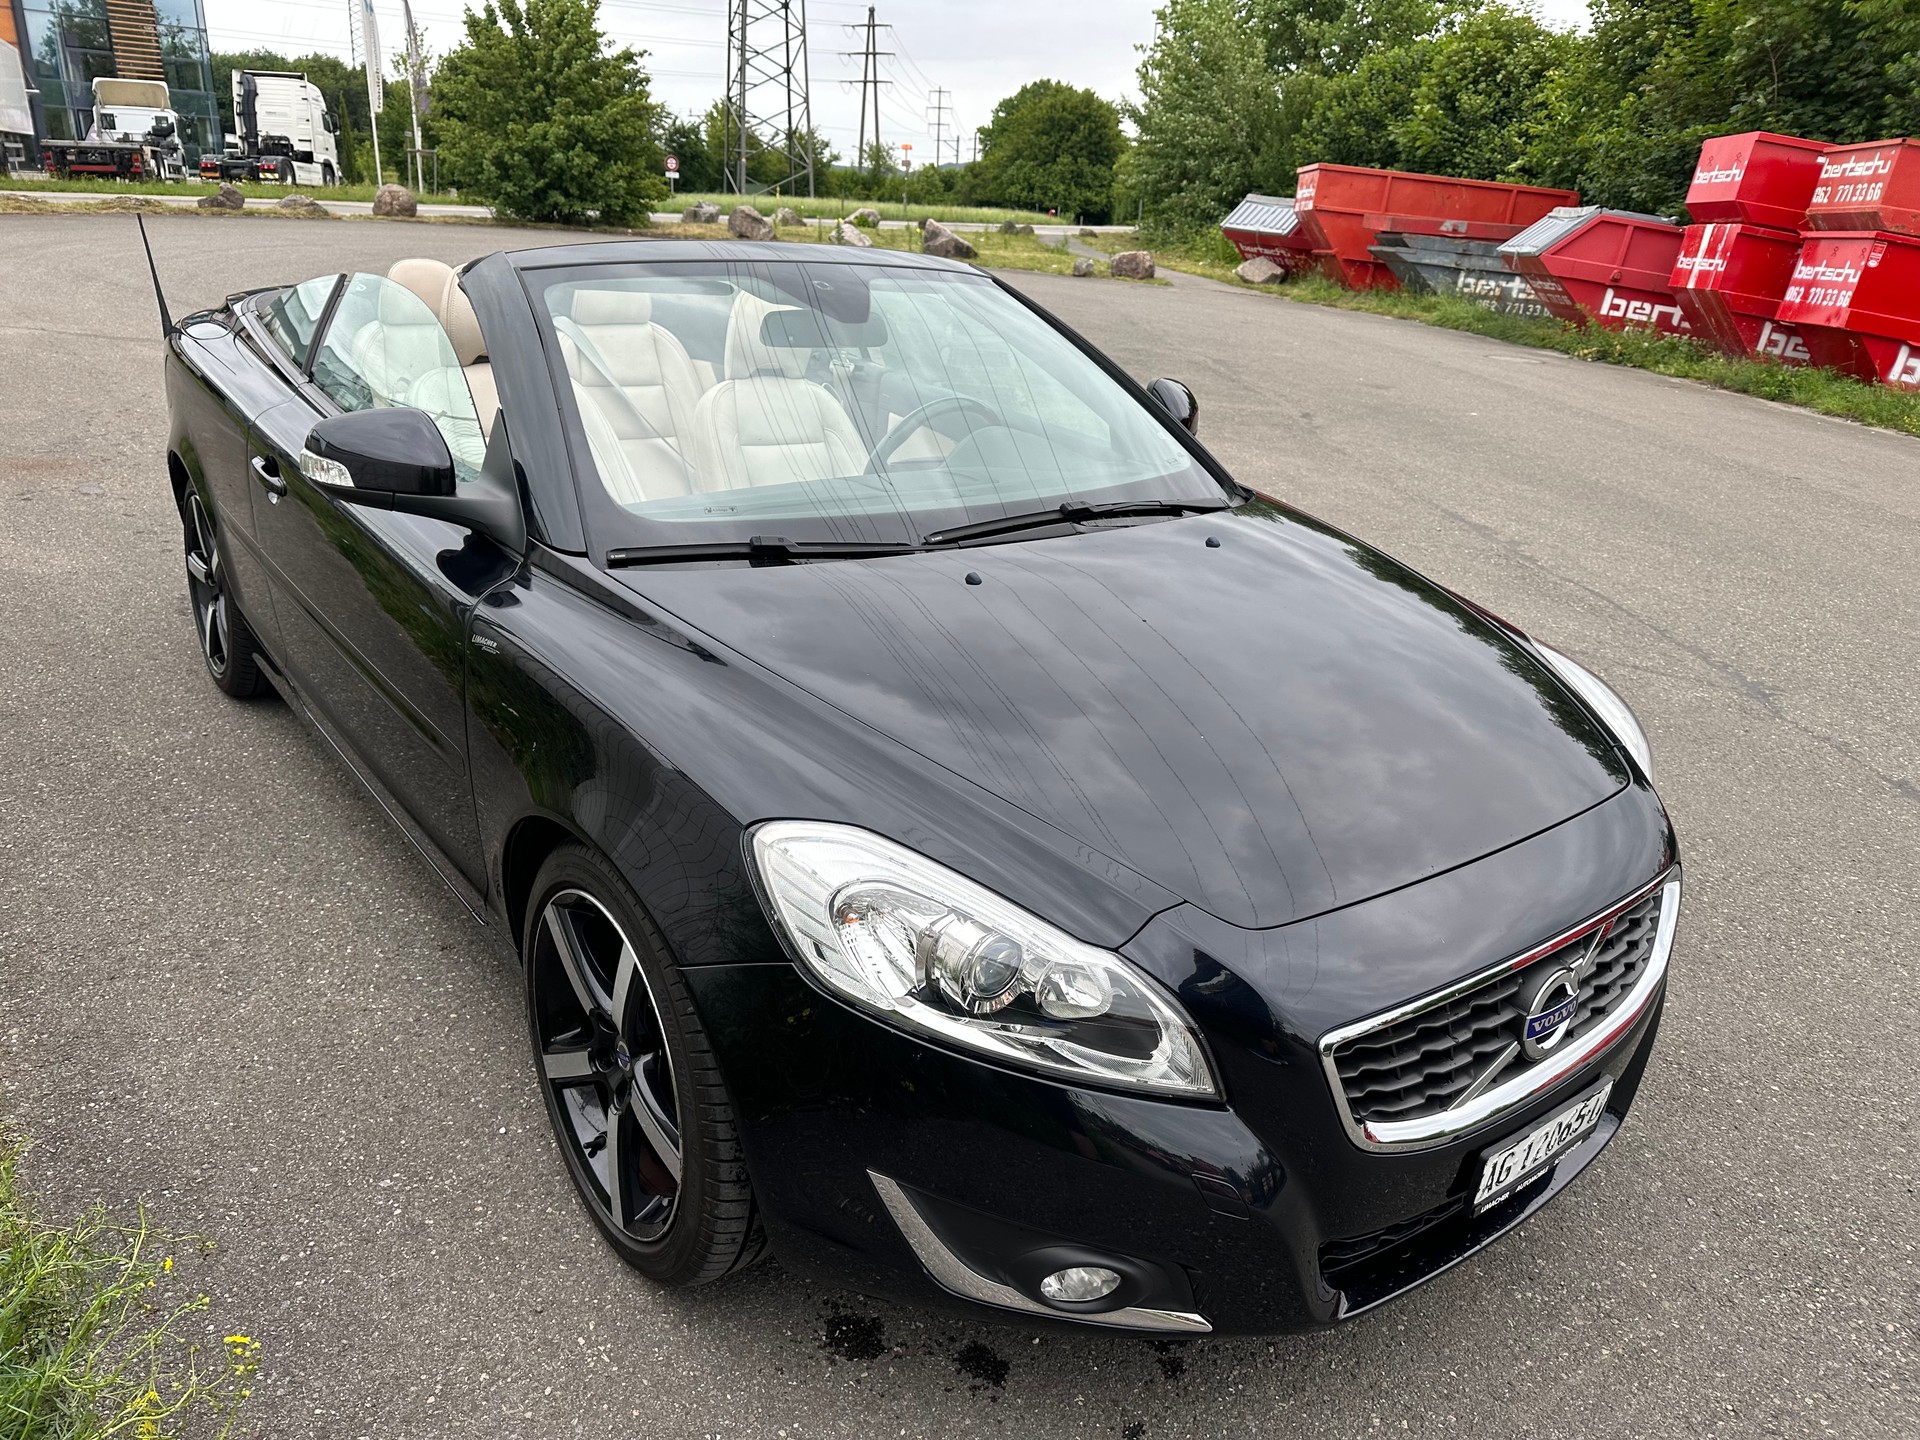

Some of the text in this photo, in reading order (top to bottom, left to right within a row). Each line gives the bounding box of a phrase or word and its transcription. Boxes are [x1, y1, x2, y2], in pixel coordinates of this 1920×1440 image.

[1693, 161, 1748, 184] bertschi
[1821, 149, 1896, 179] bertschi
[1811, 186, 1832, 203] 062
[1676, 249, 1731, 271] bertschi
[1794, 258, 1866, 283] bertschi
[1785, 286, 1805, 304] 062
[1532, 1000, 1577, 1032] VOLVO
[1482, 1150, 1515, 1194] AG
